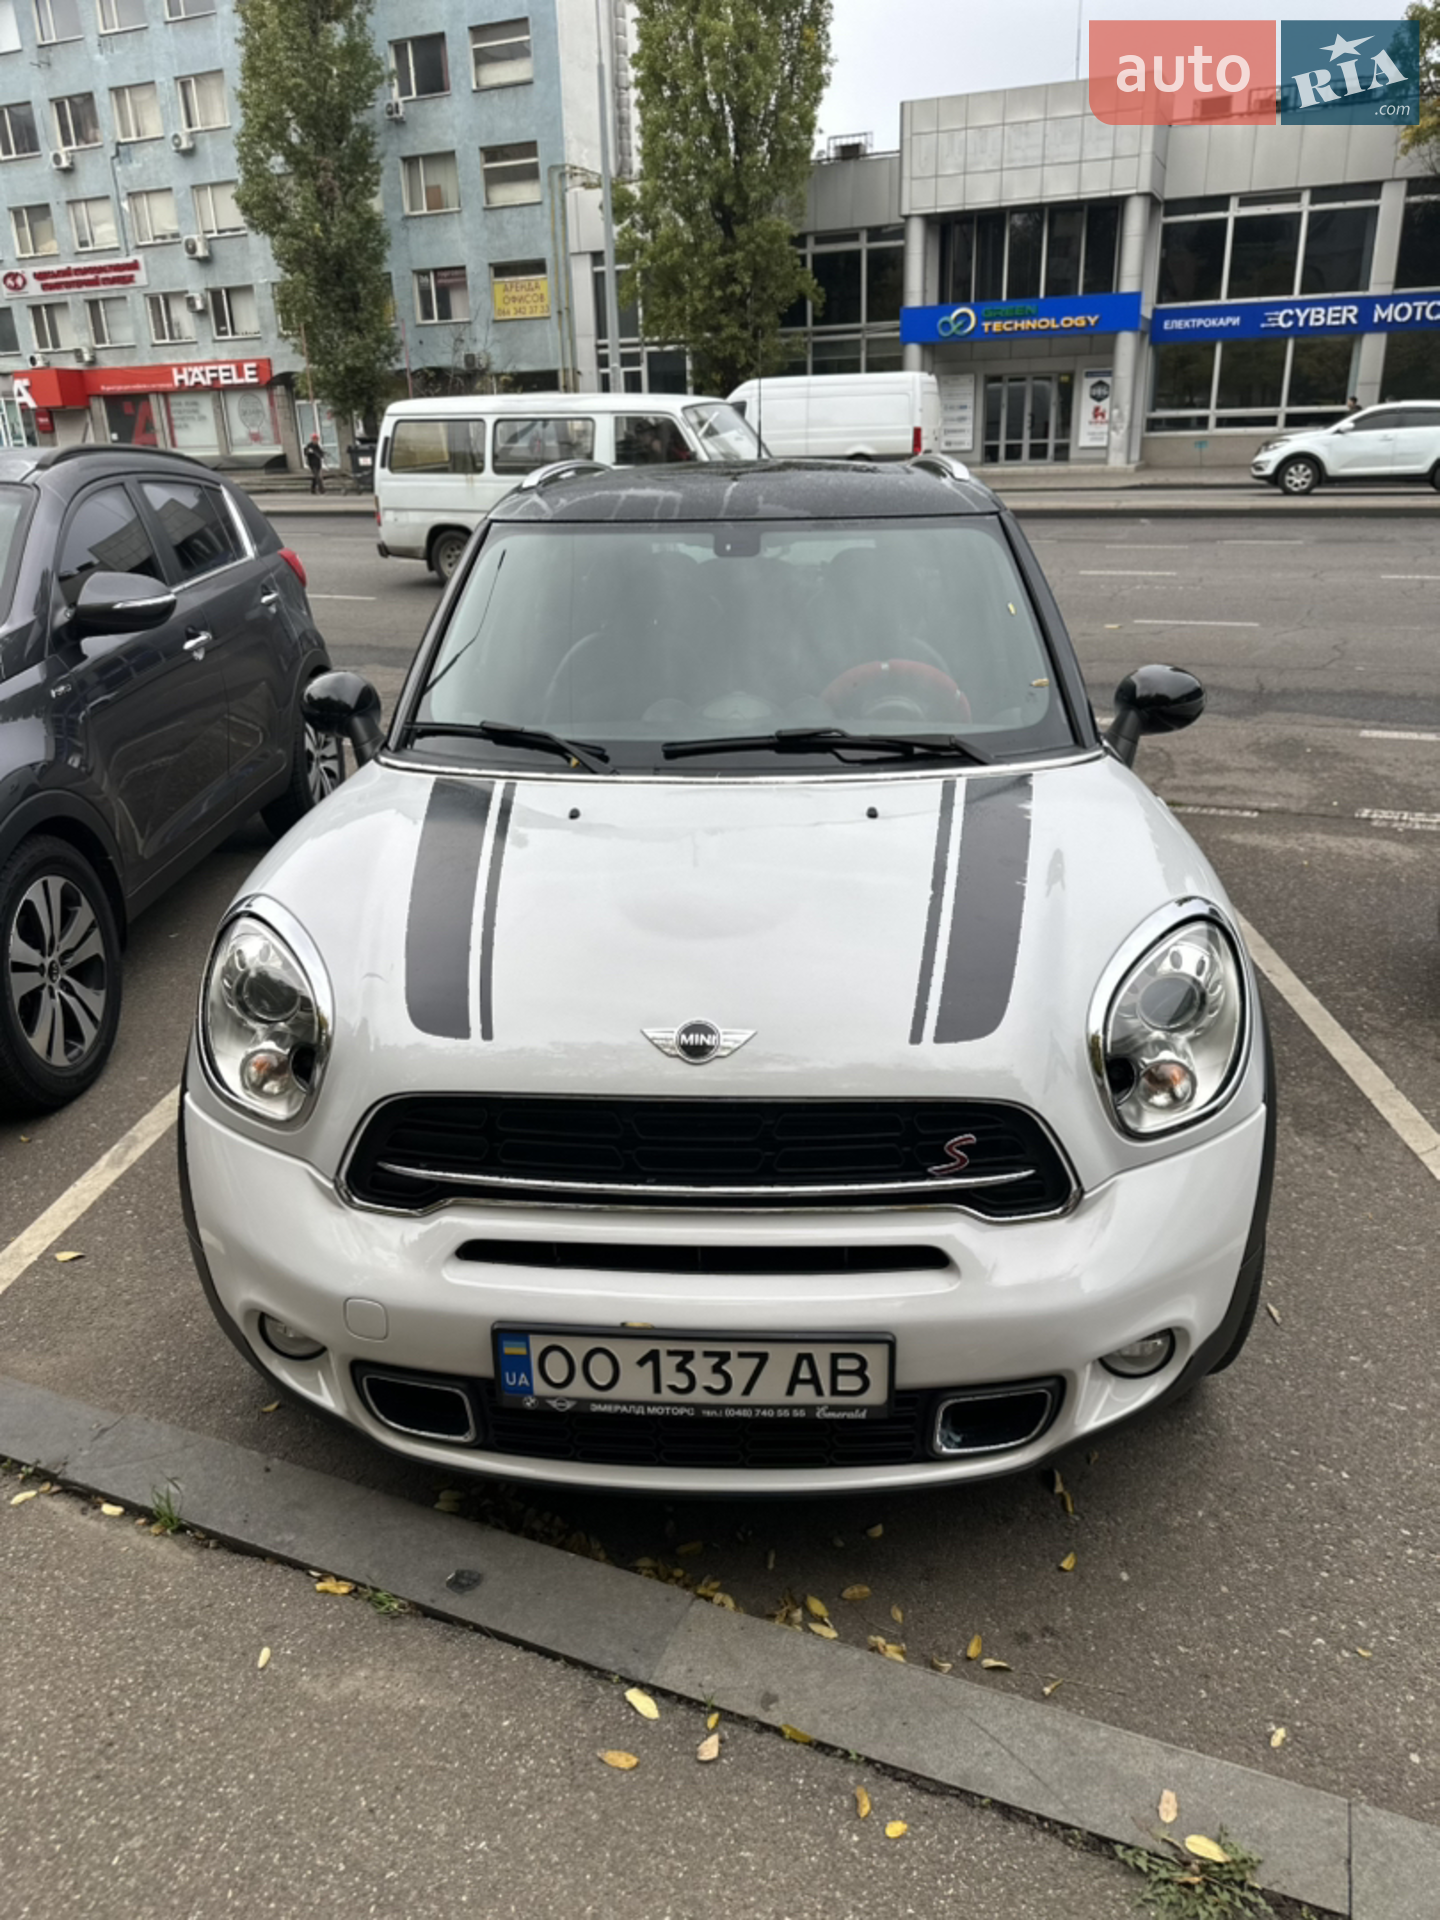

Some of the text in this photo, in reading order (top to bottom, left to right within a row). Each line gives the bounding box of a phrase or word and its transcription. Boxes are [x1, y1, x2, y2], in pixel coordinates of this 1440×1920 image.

[503, 281, 541, 293] АРЕНДА
[503, 293, 546, 305] ОФИСОВ
[981, 305, 1038, 318] GREEN
[1278, 305, 1359, 329] CYBER
[981, 314, 1099, 333] TECHNOLOGY
[1163, 316, 1241, 331] ЕЛЕКТРОКАРИ
[172, 362, 259, 387] HÄFELE
[680, 1033, 718, 1047] MINI
[928, 1133, 977, 1176] S
[537, 1343, 871, 1398] OO 1337 AB
[505, 1372, 530, 1387] UA
[590, 1403, 645, 1415] ЭМЕРАЛД
[646, 1406, 695, 1417] МОТОРС
[755, 1409, 774, 1418] 740
[777, 1409, 790, 1418] 55
[792, 1409, 806, 1418] 55
[815, 1405, 868, 1419] Emerald
